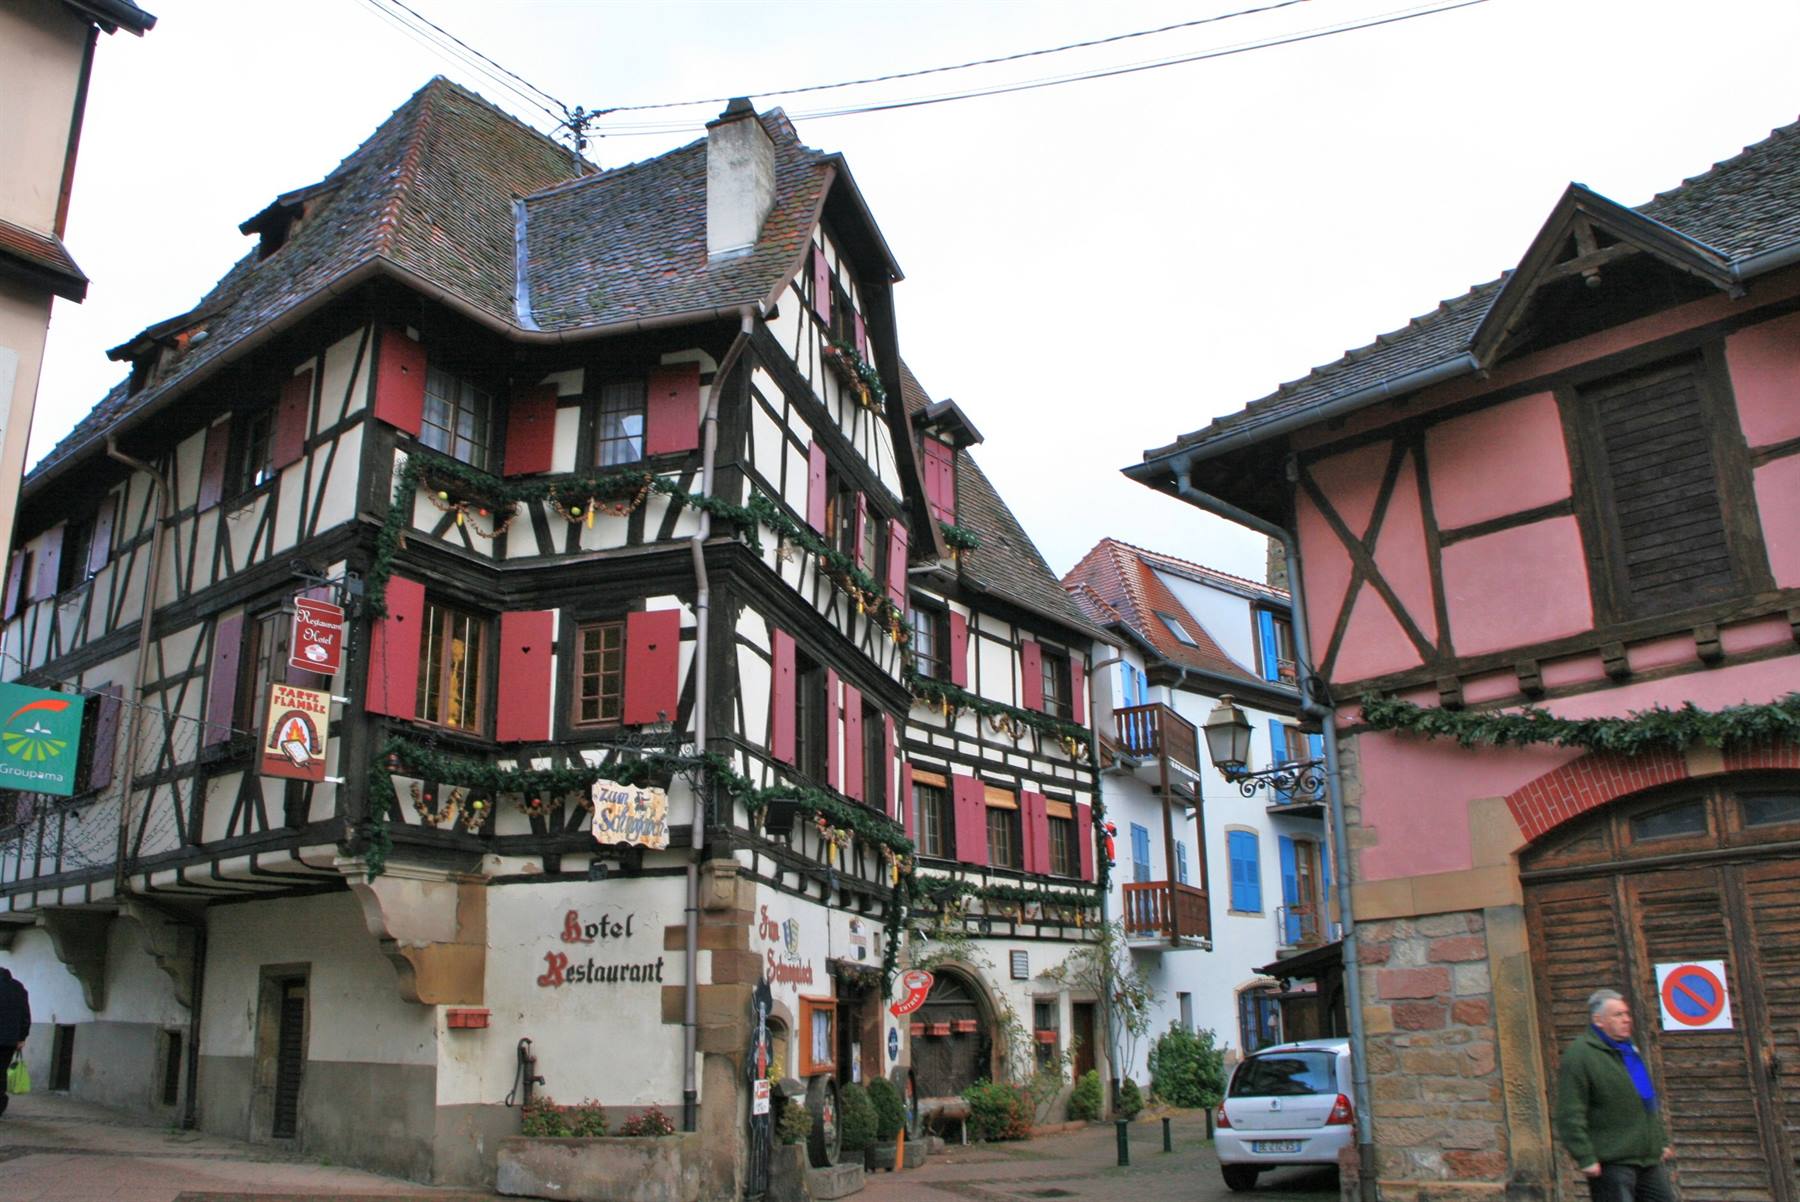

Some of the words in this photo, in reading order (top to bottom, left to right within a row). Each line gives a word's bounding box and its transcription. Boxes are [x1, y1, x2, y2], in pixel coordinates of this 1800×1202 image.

[303, 628, 333, 645] Hotel
[279, 687, 319, 703] TARTE
[0, 763, 64, 782] Groupama
[561, 909, 634, 944] Hotel
[537, 950, 664, 988] Restaurant
